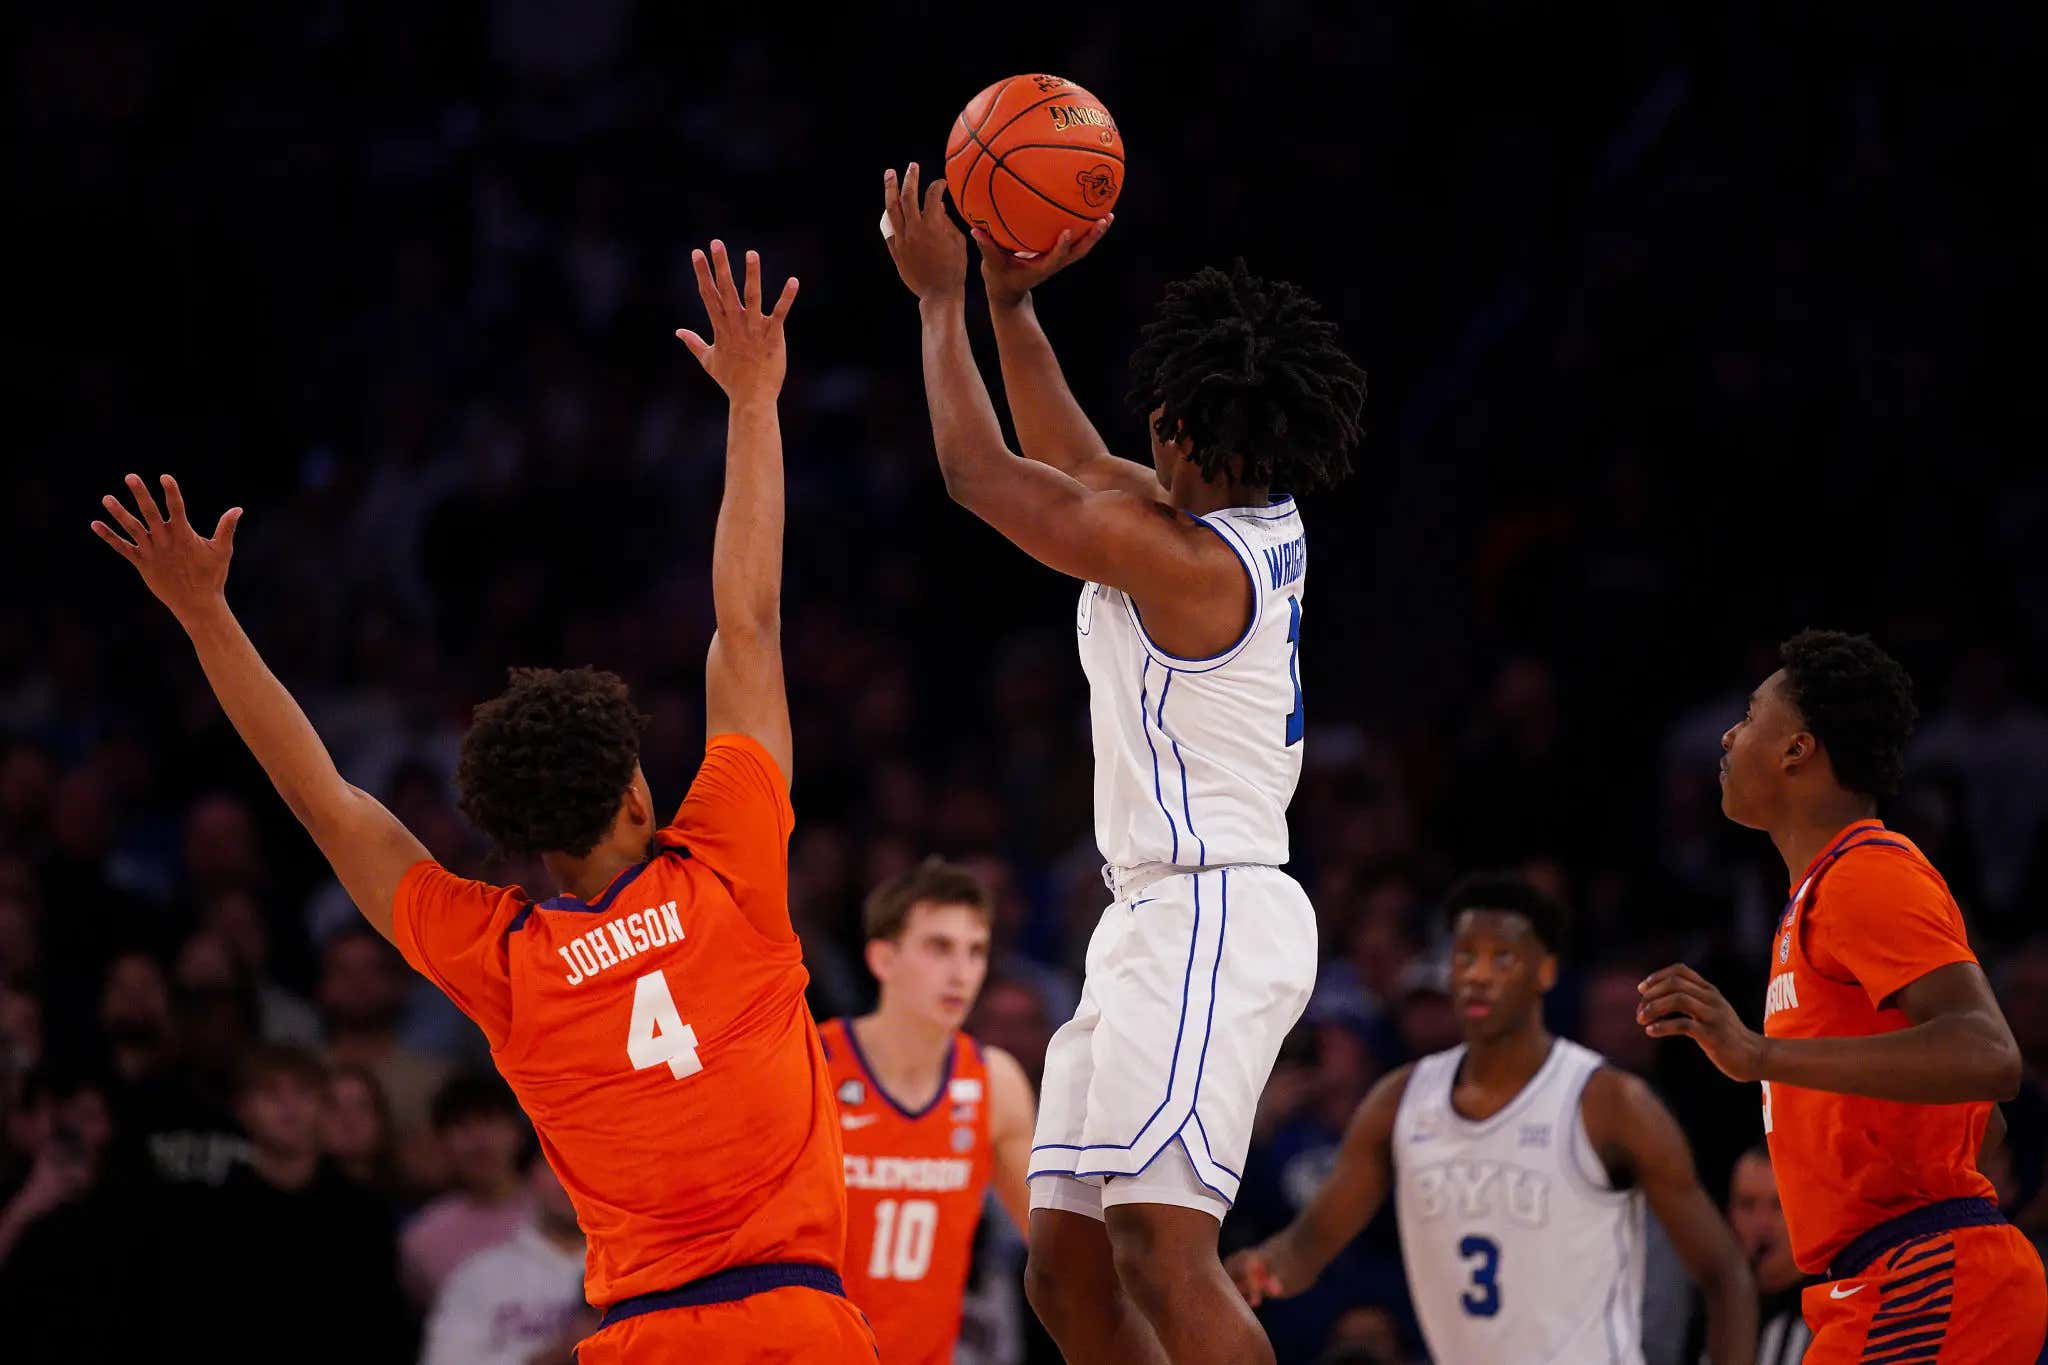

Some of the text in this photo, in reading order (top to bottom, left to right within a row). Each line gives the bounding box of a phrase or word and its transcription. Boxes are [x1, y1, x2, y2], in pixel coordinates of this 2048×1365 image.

[1264, 533, 1304, 590] WRIGH
[1286, 595, 1303, 747] 1
[558, 901, 686, 985] JOHNSON
[627, 969, 703, 1081] 4
[869, 1199, 938, 1280] 10
[1459, 1234, 1500, 1317] 3
